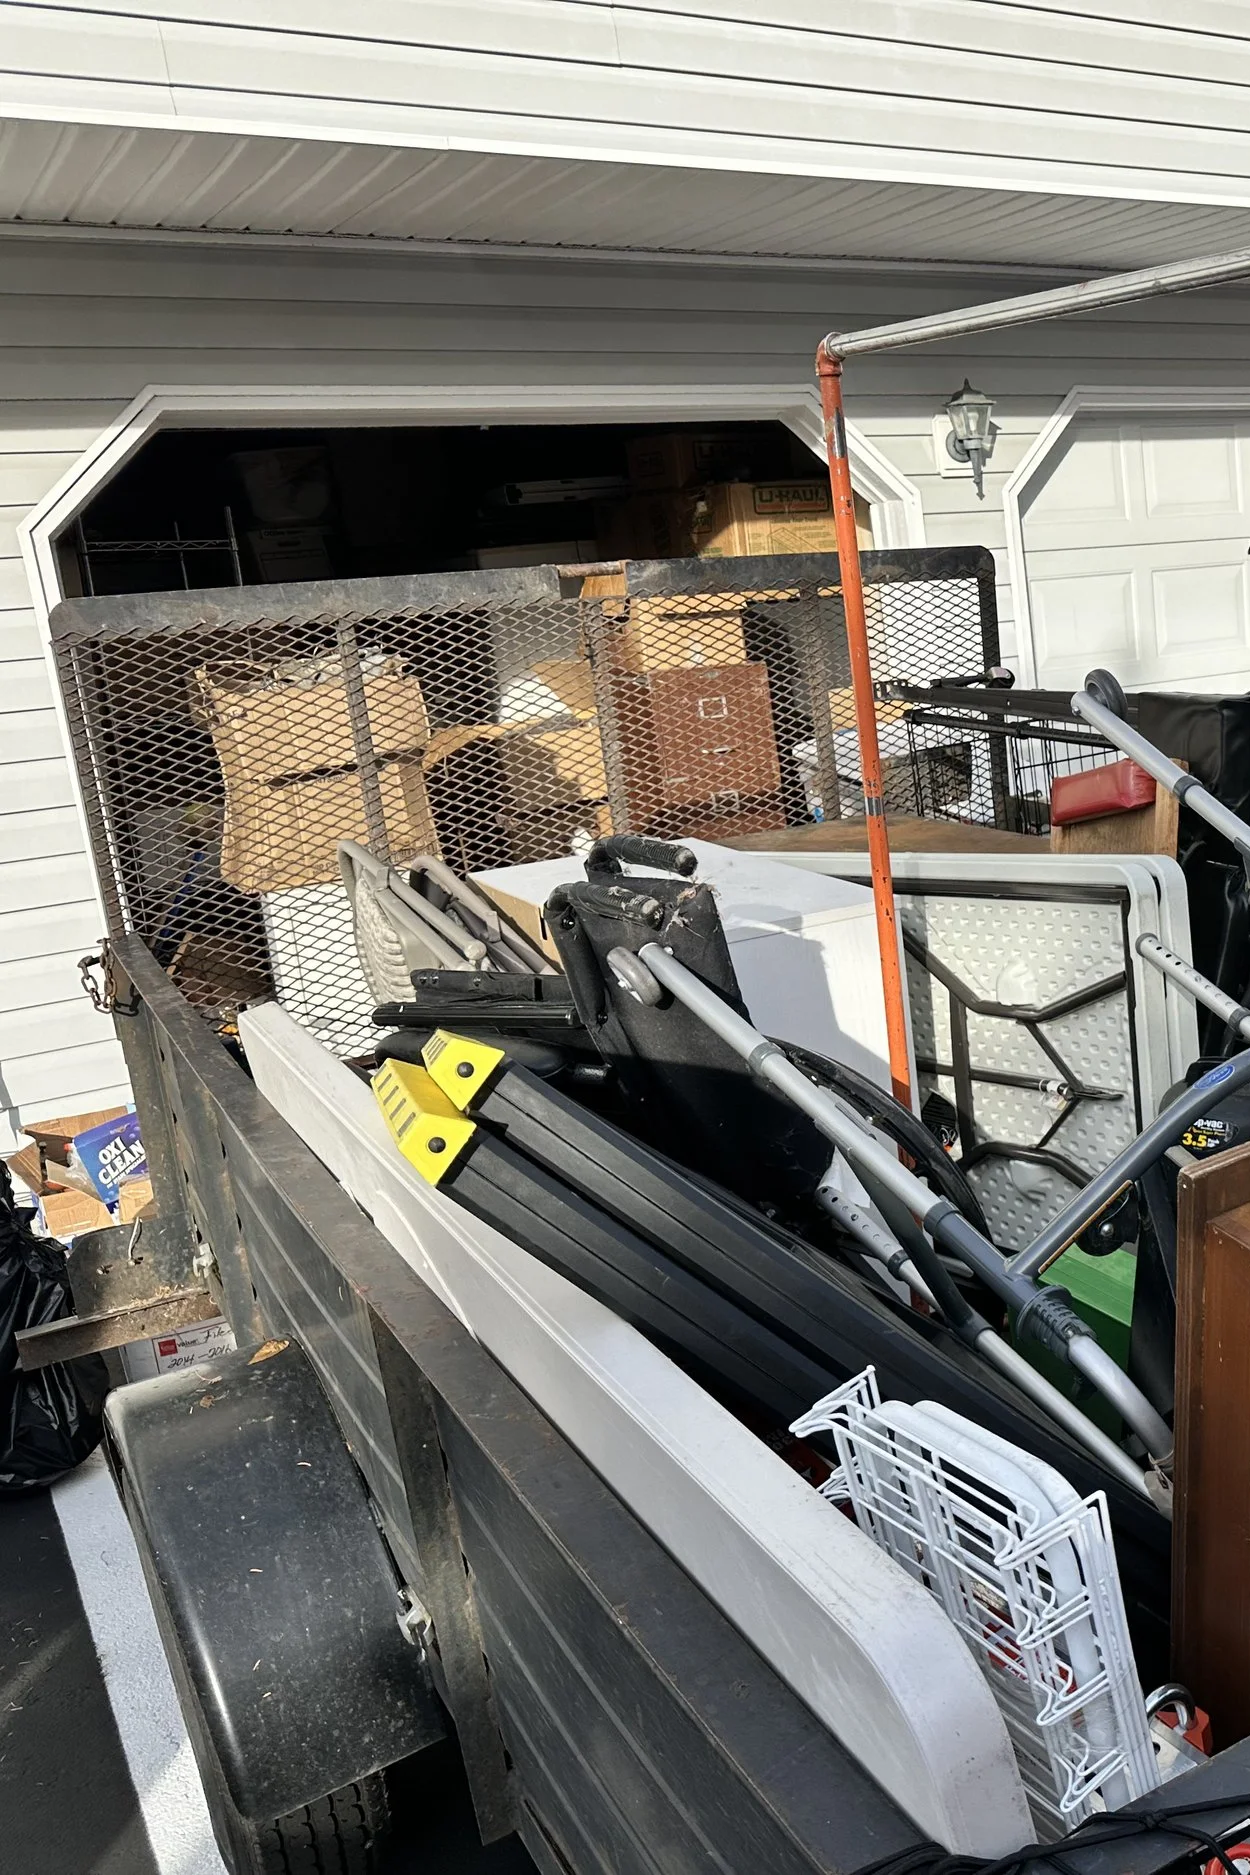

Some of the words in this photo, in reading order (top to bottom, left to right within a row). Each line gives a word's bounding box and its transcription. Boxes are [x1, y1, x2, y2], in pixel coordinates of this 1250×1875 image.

[758, 488, 824, 503] U-HAUL
[98, 1136, 127, 1165] OXI
[1182, 1132, 1208, 1148] 3.5
[98, 1140, 146, 1185] CLEAN
